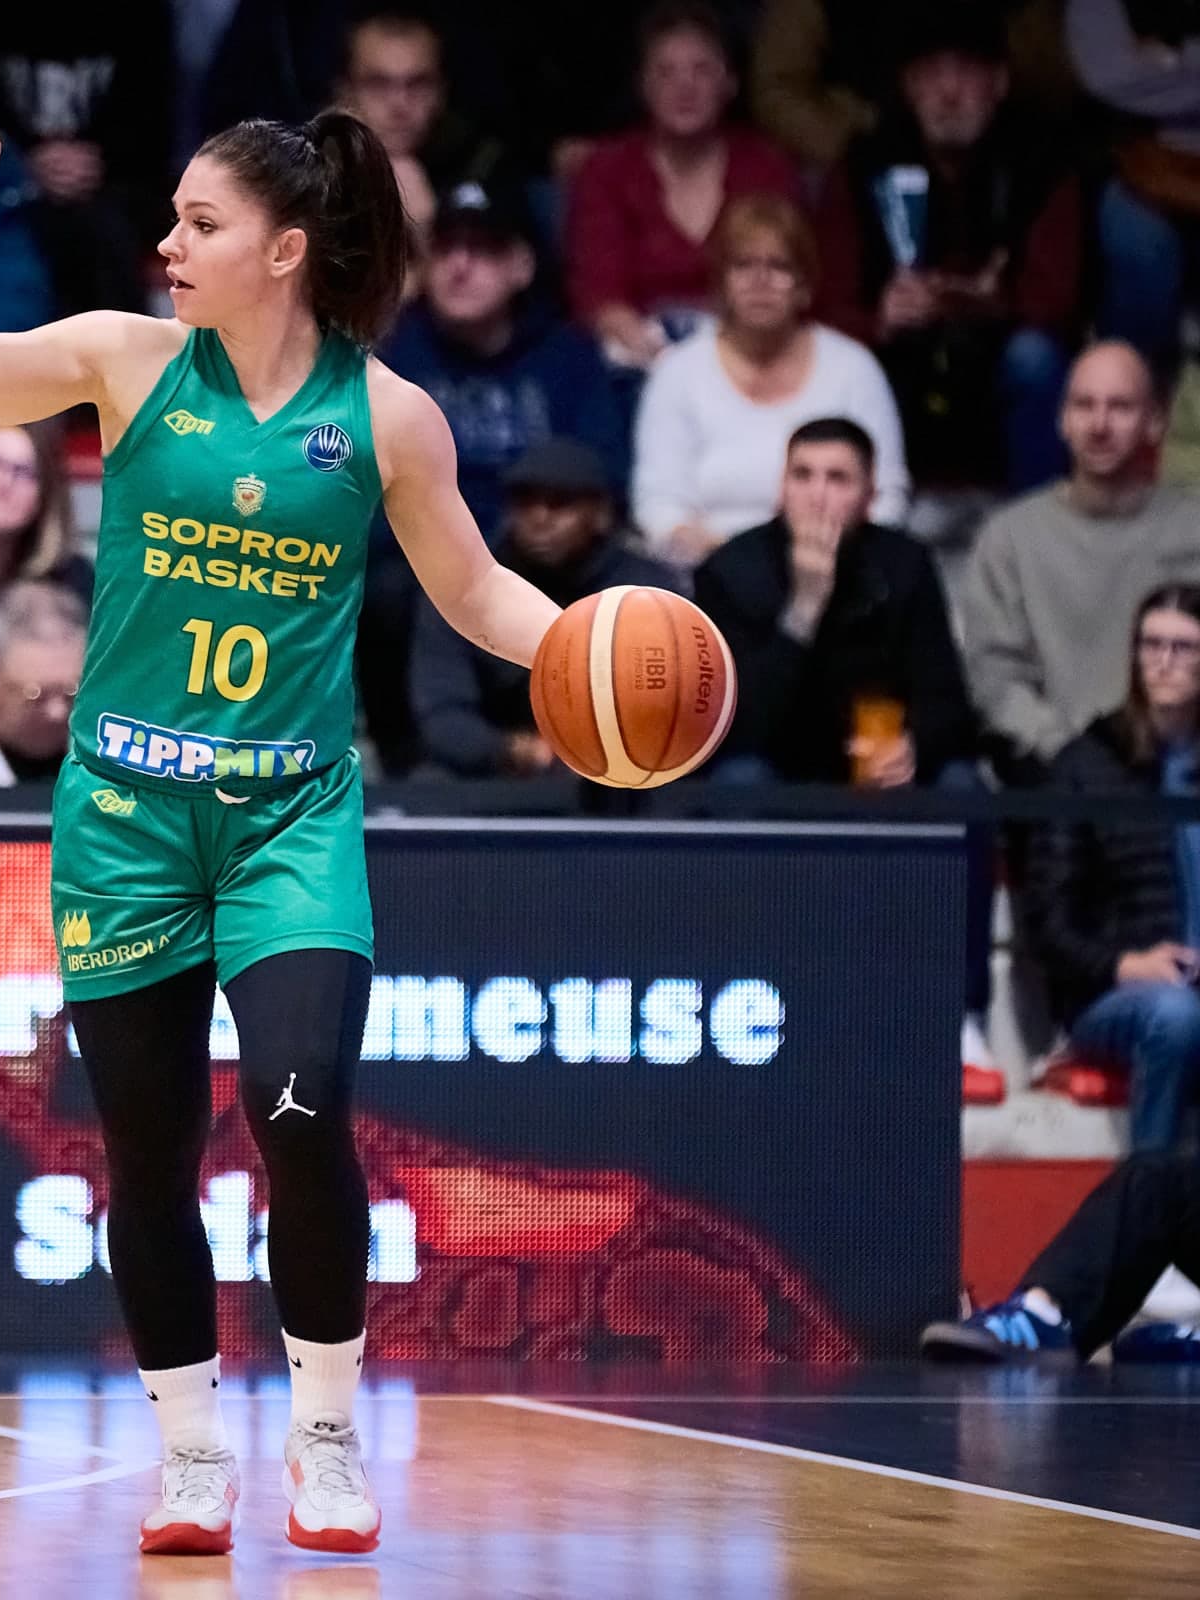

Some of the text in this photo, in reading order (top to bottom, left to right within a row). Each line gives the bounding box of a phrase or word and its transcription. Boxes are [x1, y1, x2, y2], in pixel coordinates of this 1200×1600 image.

[142, 511, 342, 567] SOPRON
[143, 547, 327, 600] BASKET
[181, 618, 268, 702] 10
[645, 647, 666, 690] FIBA
[692, 626, 714, 713] molten
[67, 934, 170, 972] IBERDROLA
[15, 1171, 421, 1282] Sdn
